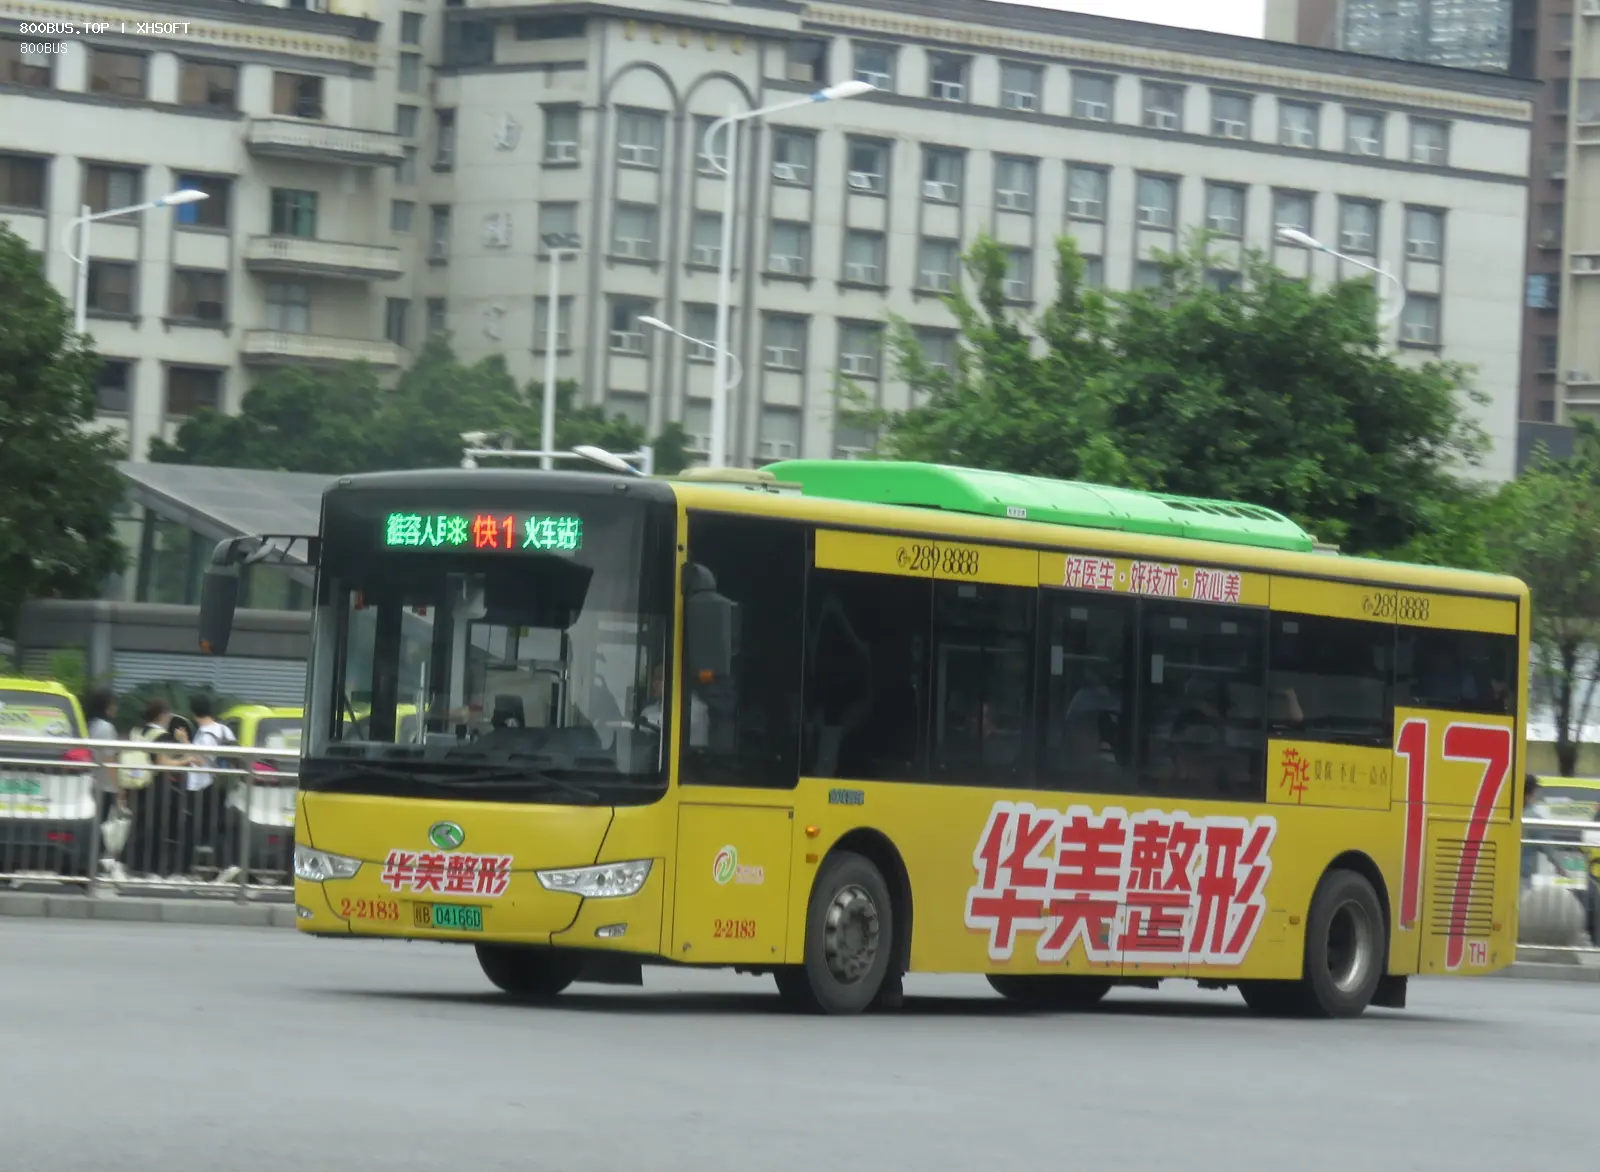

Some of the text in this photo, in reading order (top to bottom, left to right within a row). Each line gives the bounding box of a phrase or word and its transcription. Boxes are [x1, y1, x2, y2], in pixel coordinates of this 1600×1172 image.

[522, 515, 579, 550] 火车站
[1397, 719, 1511, 970] 17
[382, 850, 513, 896] 华美整形
[967, 806, 1274, 962] 华美整形
[340, 898, 400, 921] 2-2183
[713, 918, 756, 939] 2-2183
